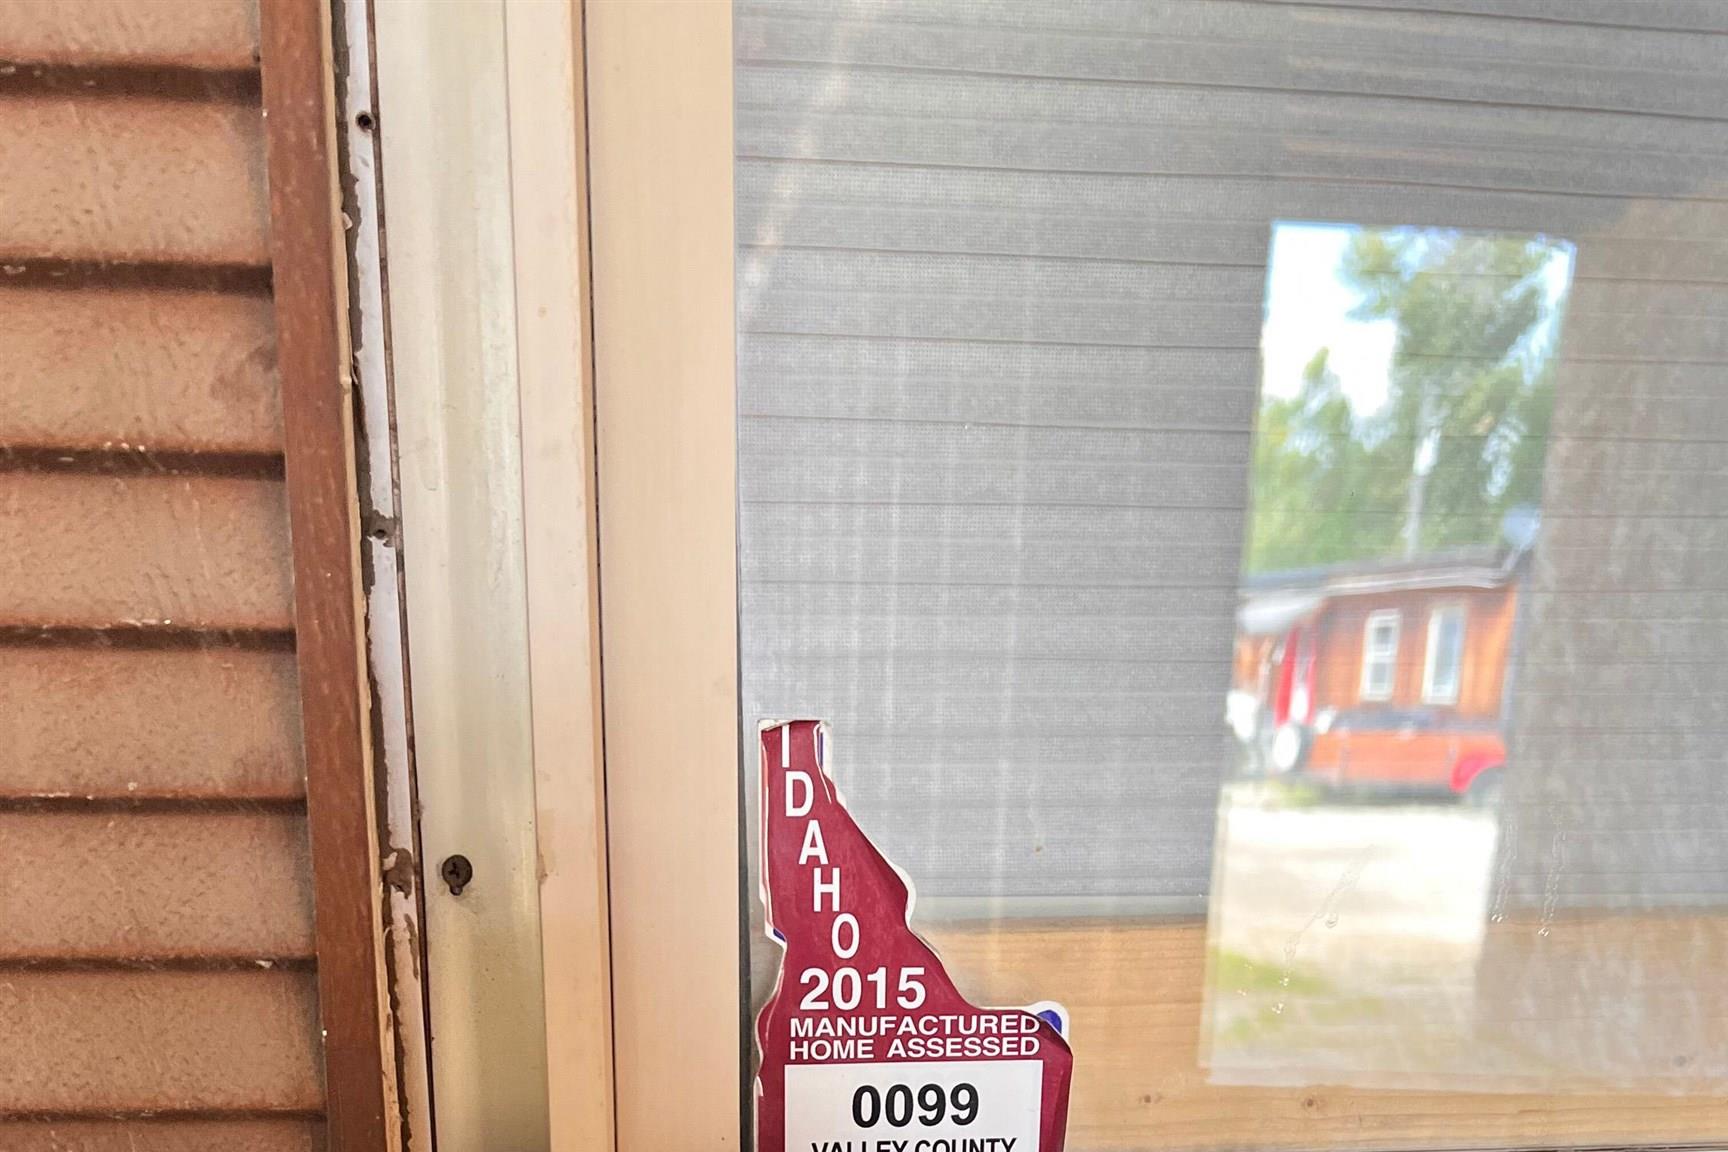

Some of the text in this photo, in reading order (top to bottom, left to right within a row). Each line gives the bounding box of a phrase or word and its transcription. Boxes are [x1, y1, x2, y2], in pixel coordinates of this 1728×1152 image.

[781, 725, 860, 959] IDAHO
[800, 967, 926, 1011] 2015
[790, 1015, 1041, 1038] MANUFACTURED
[790, 1037, 1041, 1060] HOME ASSESSED
[852, 1083, 979, 1129] 0099
